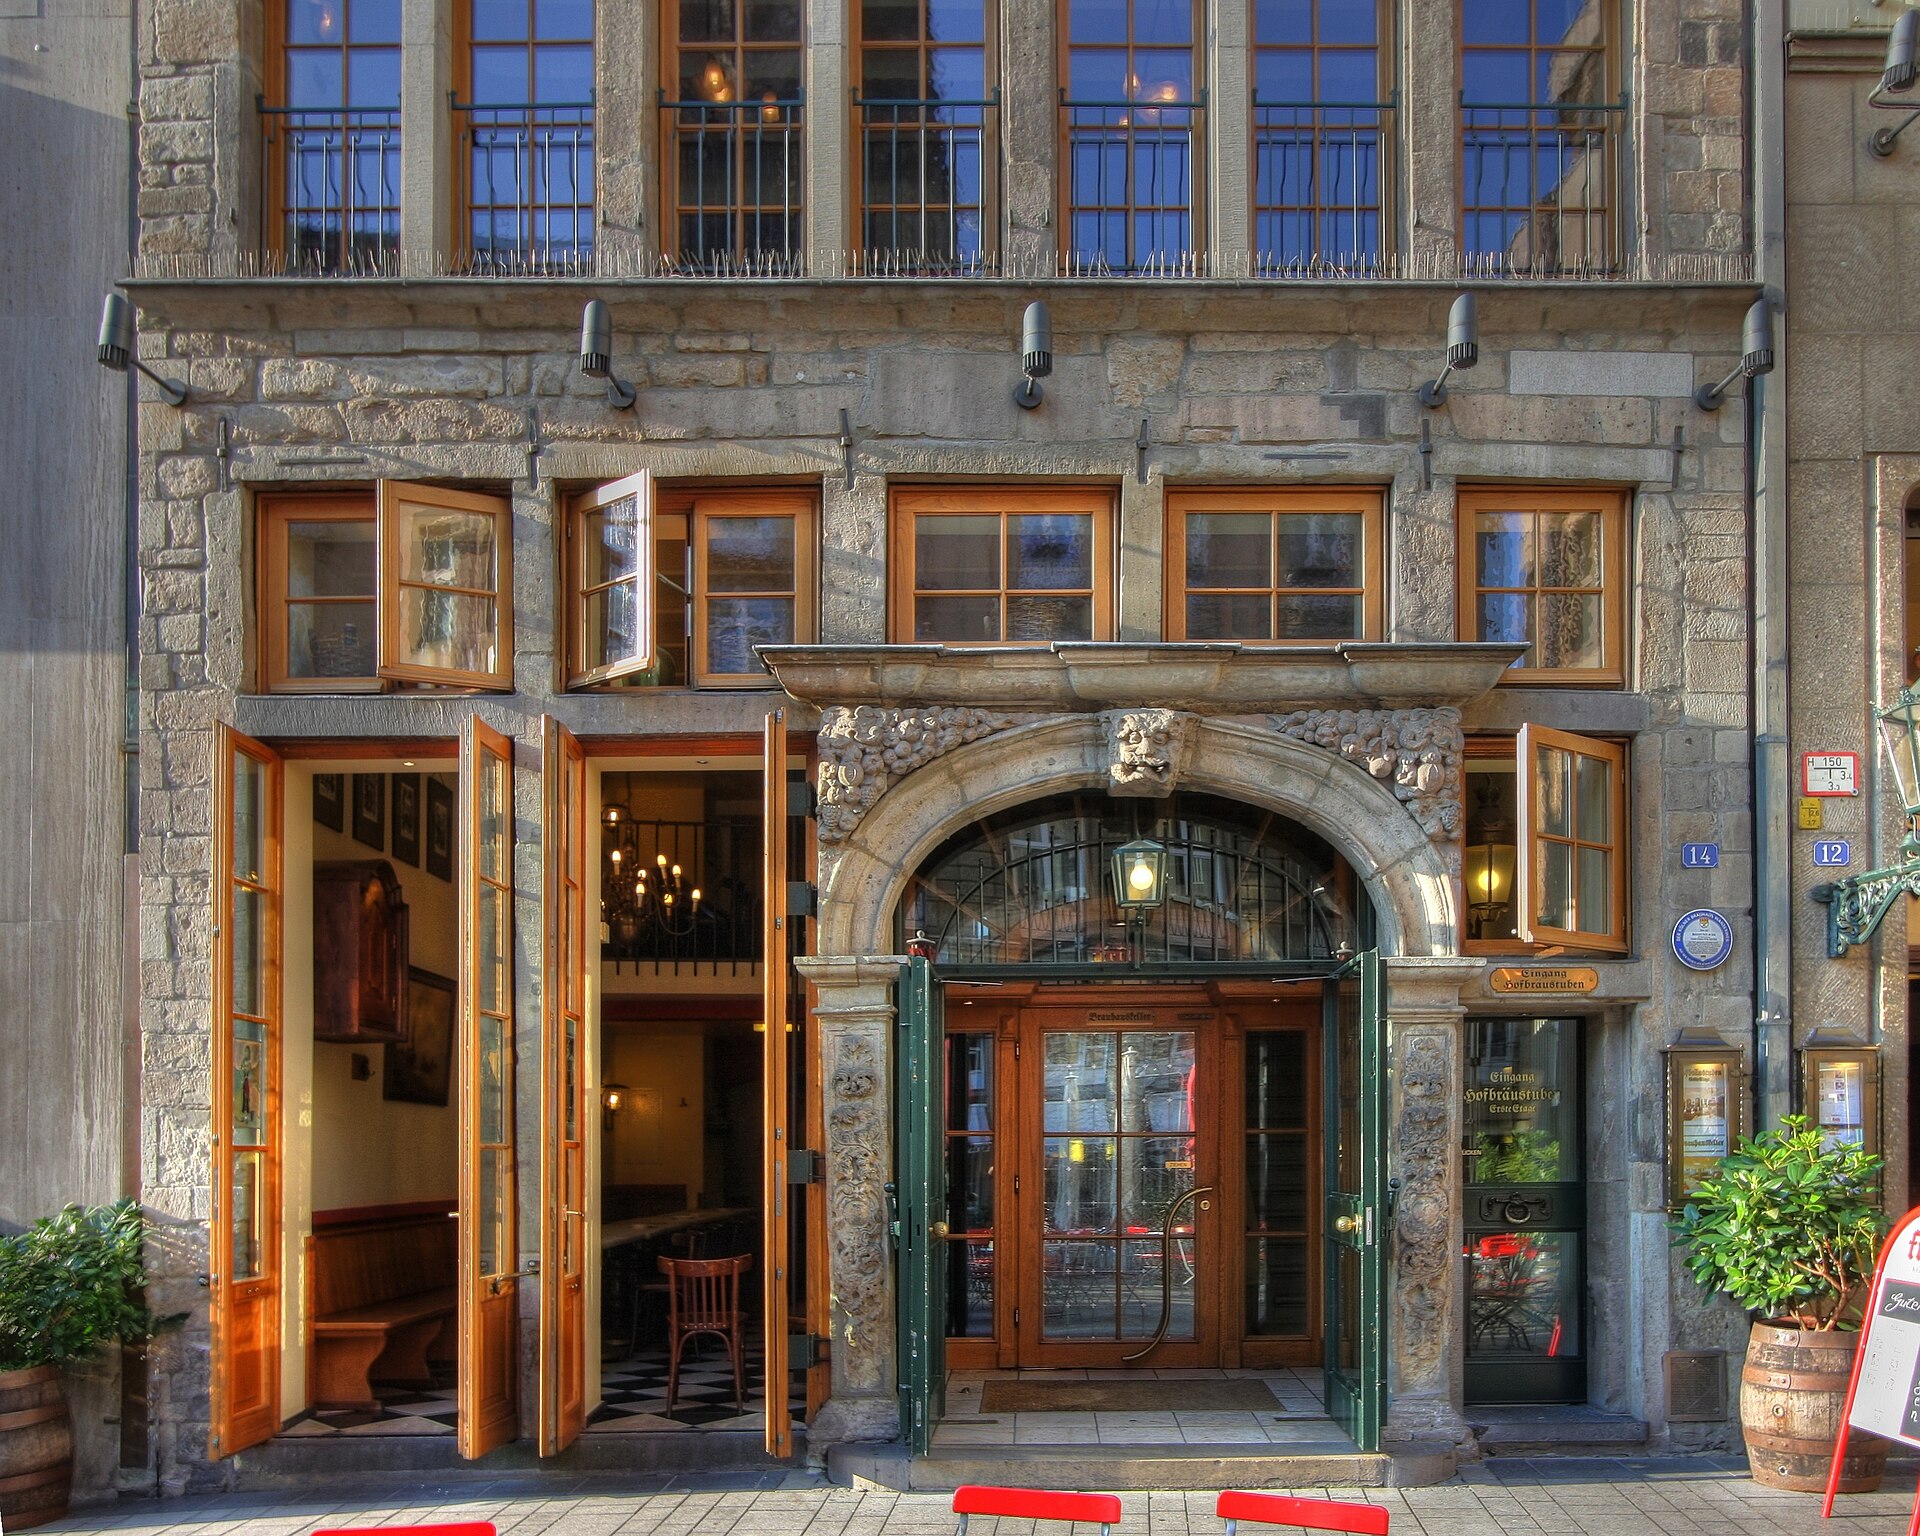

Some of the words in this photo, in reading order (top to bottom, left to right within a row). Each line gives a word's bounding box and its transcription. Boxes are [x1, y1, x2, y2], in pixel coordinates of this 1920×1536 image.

[1807, 757, 1815, 767] H
[1822, 757, 1842, 767] 150
[1690, 846, 1711, 864] 14
[1821, 844, 1842, 863] 12
[1521, 969, 1567, 979] Eingang
[1490, 1071, 1535, 1084] Eingang
[1489, 1103, 1512, 1114] Erste
[1461, 1148, 1482, 1156] ÜCKEN
